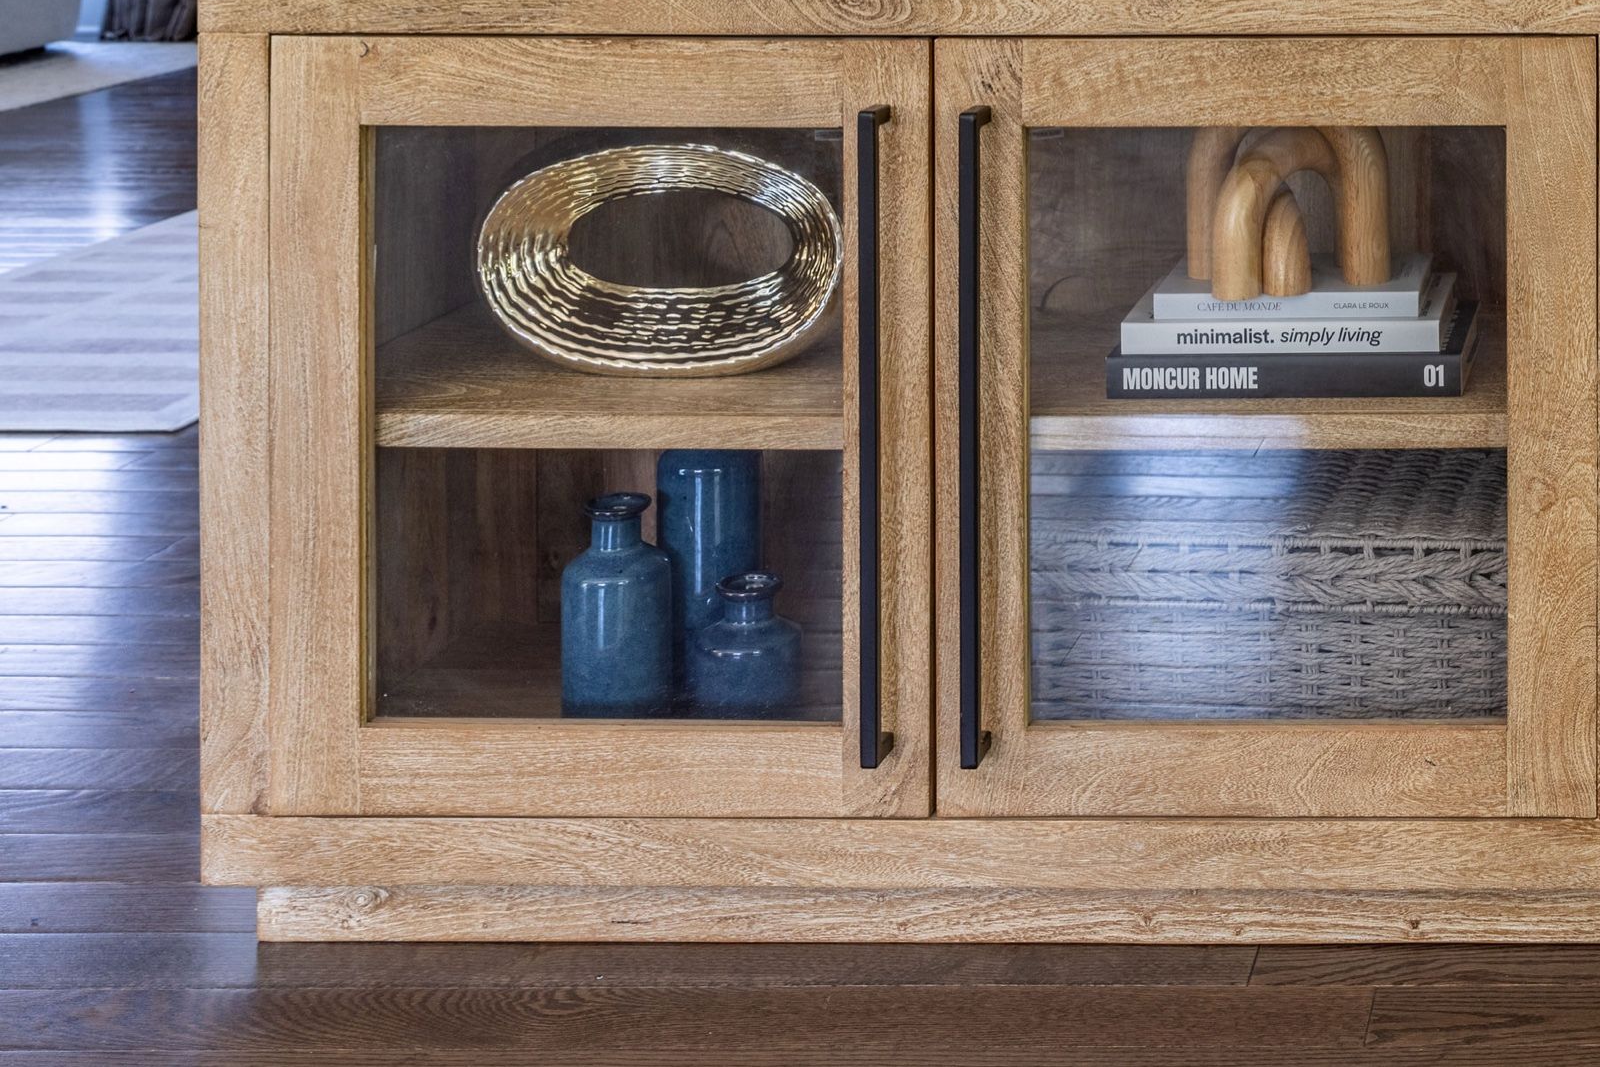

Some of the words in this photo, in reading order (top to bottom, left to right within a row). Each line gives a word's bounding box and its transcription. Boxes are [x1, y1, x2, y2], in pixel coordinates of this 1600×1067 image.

[1226, 301, 1240, 312] DU
[1243, 301, 1282, 311] MONDE
[1177, 328, 1275, 345] minimalist.
[1280, 327, 1335, 347] simply
[1338, 327, 1383, 347] living
[1122, 366, 1200, 390] MONCUR
[1205, 365, 1259, 390] HOME
[1423, 364, 1445, 387] 01
